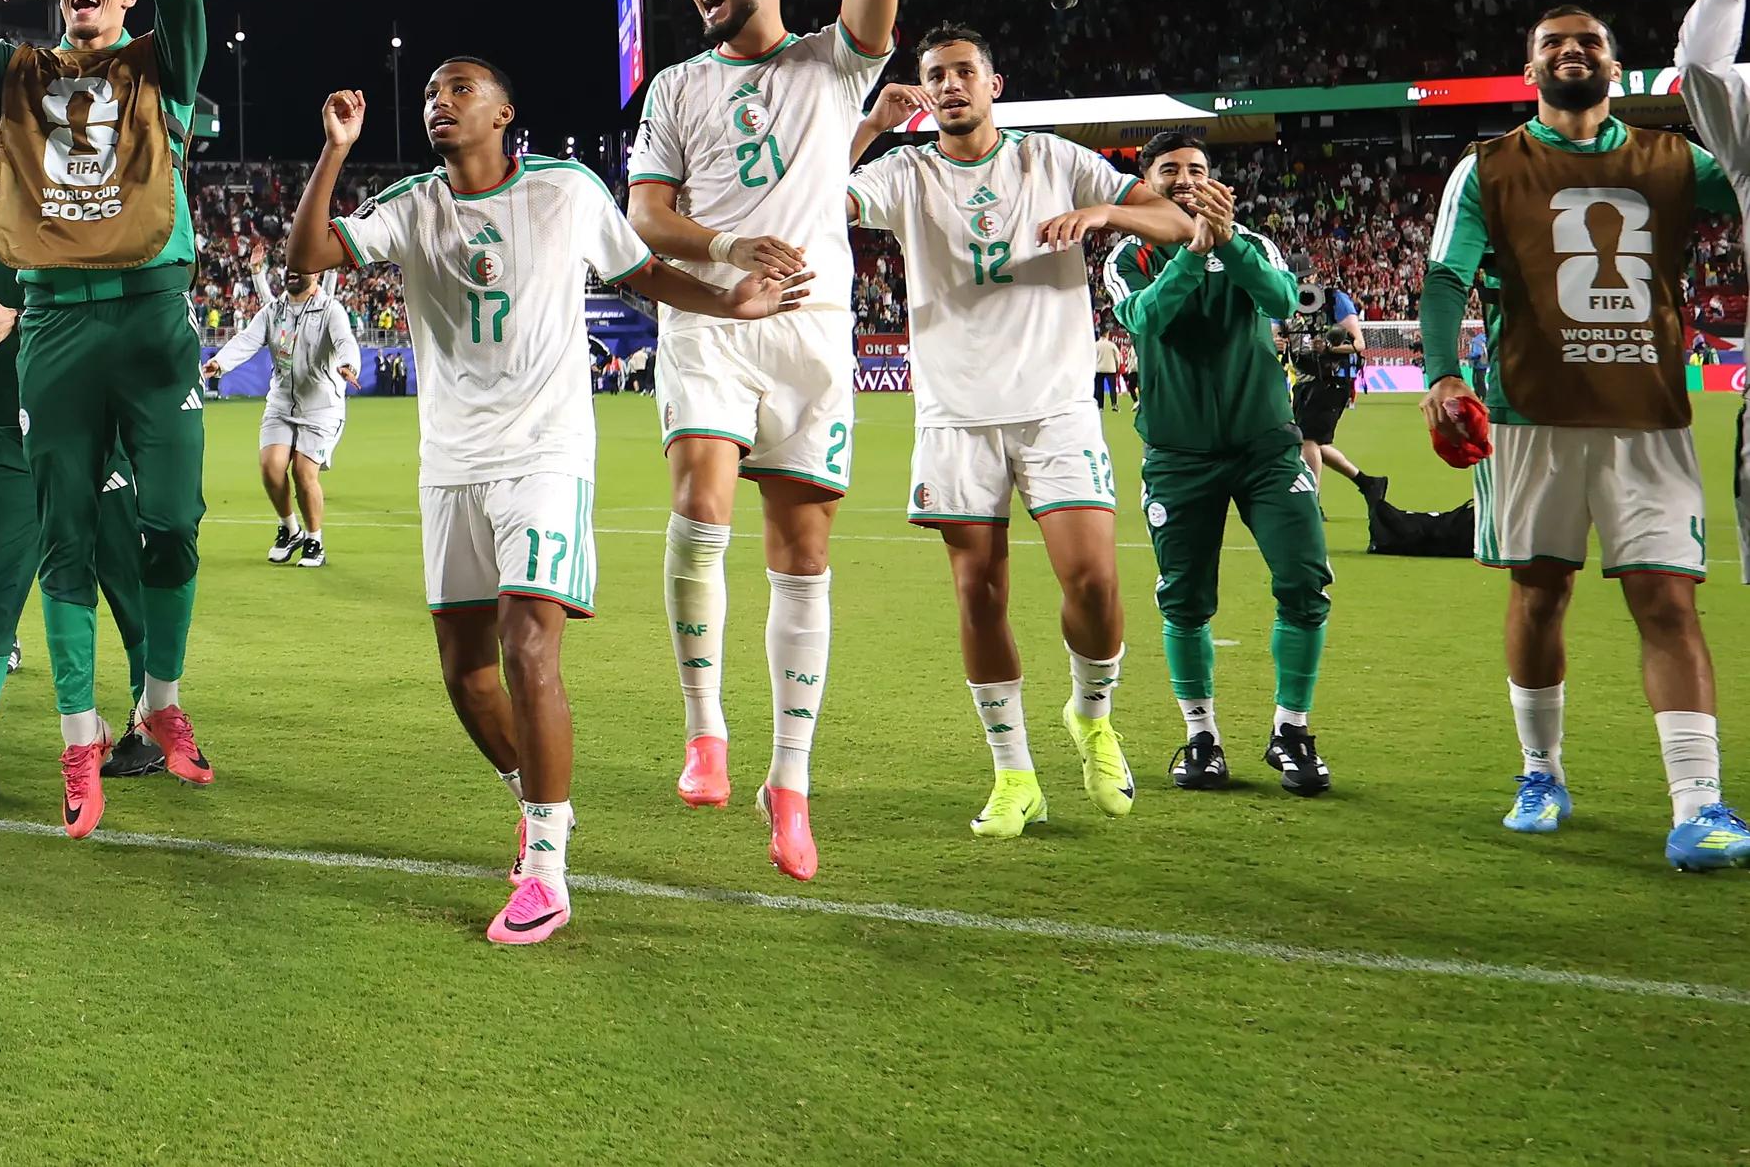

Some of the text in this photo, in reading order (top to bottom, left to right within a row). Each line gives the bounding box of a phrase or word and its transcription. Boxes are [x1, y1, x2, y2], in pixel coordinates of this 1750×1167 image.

[66, 161, 102, 175] FIFA
[736, 135, 786, 188] 21
[42, 186, 120, 201] WORLD CUP
[40, 199, 122, 221] 2026
[969, 241, 1013, 285] 12
[1588, 296, 1635, 309] FIFA
[467, 291, 510, 344] 17
[1560, 329, 1627, 341] WORLD
[865, 344, 892, 355] ONE
[1562, 343, 1659, 364] 2026
[526, 528, 567, 584] 17
[676, 620, 707, 636] FAF
[785, 669, 819, 685] FAF
[980, 698, 1009, 708] FAF
[526, 806, 552, 818] FAF
